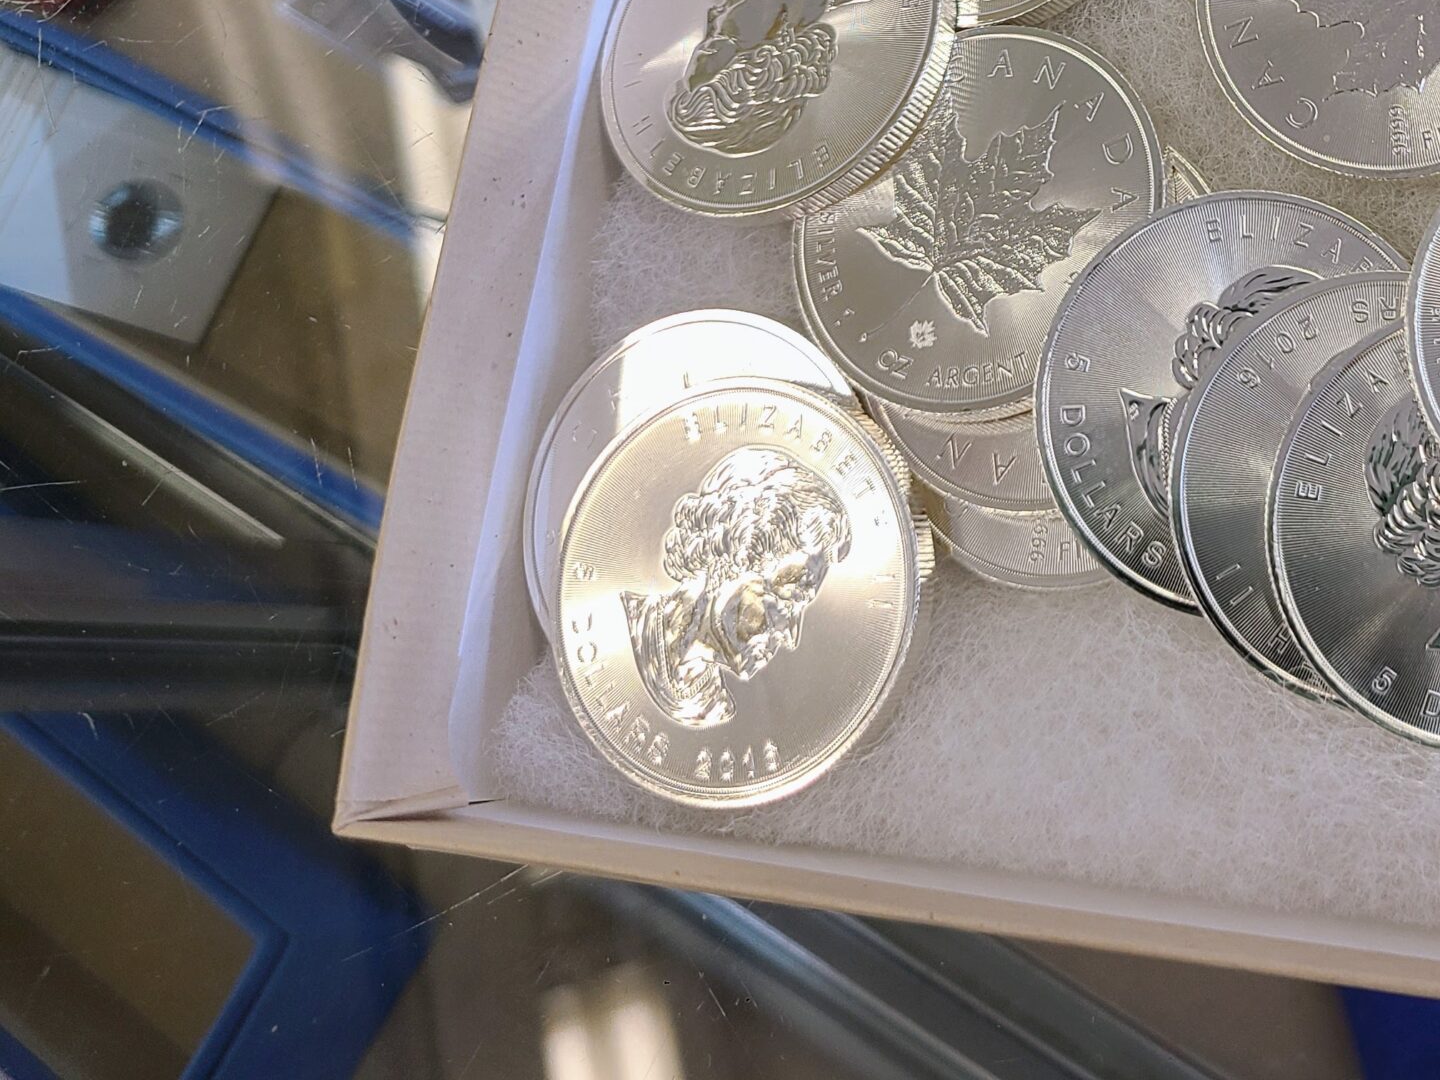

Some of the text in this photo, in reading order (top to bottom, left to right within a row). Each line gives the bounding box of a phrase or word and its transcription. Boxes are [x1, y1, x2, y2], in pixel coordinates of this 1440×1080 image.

[946, 47, 1140, 215] CANADA
[926, 351, 1029, 389] ARGENT
[1236, 316, 1320, 390] 2016
[1060, 353, 1168, 567] 5 DOLLARS
[1370, 665, 1398, 694] 5
